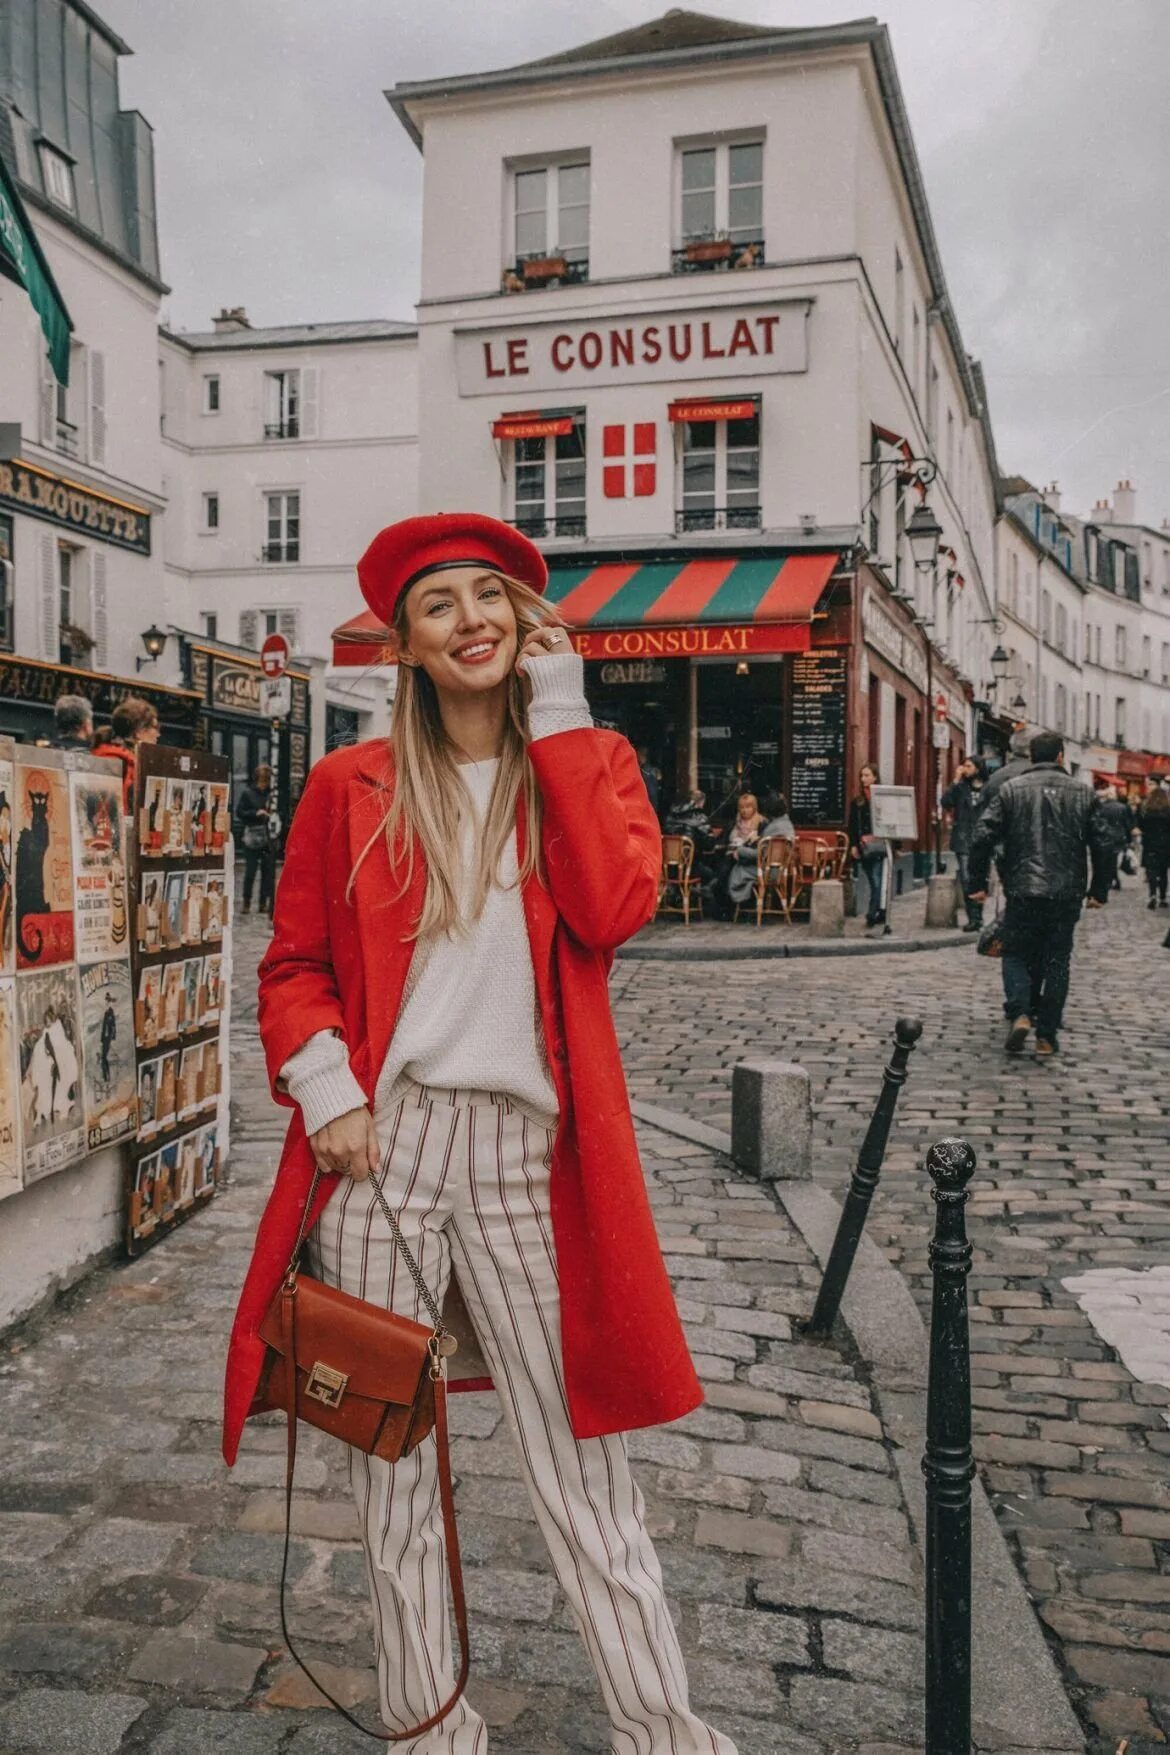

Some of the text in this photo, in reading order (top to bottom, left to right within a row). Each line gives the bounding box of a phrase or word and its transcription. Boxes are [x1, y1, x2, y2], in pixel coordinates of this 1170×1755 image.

[483, 316, 780, 378] LE CONSULAT
[677, 405, 744, 418] LE CONSULAT
[604, 628, 754, 654] CONSULAT
